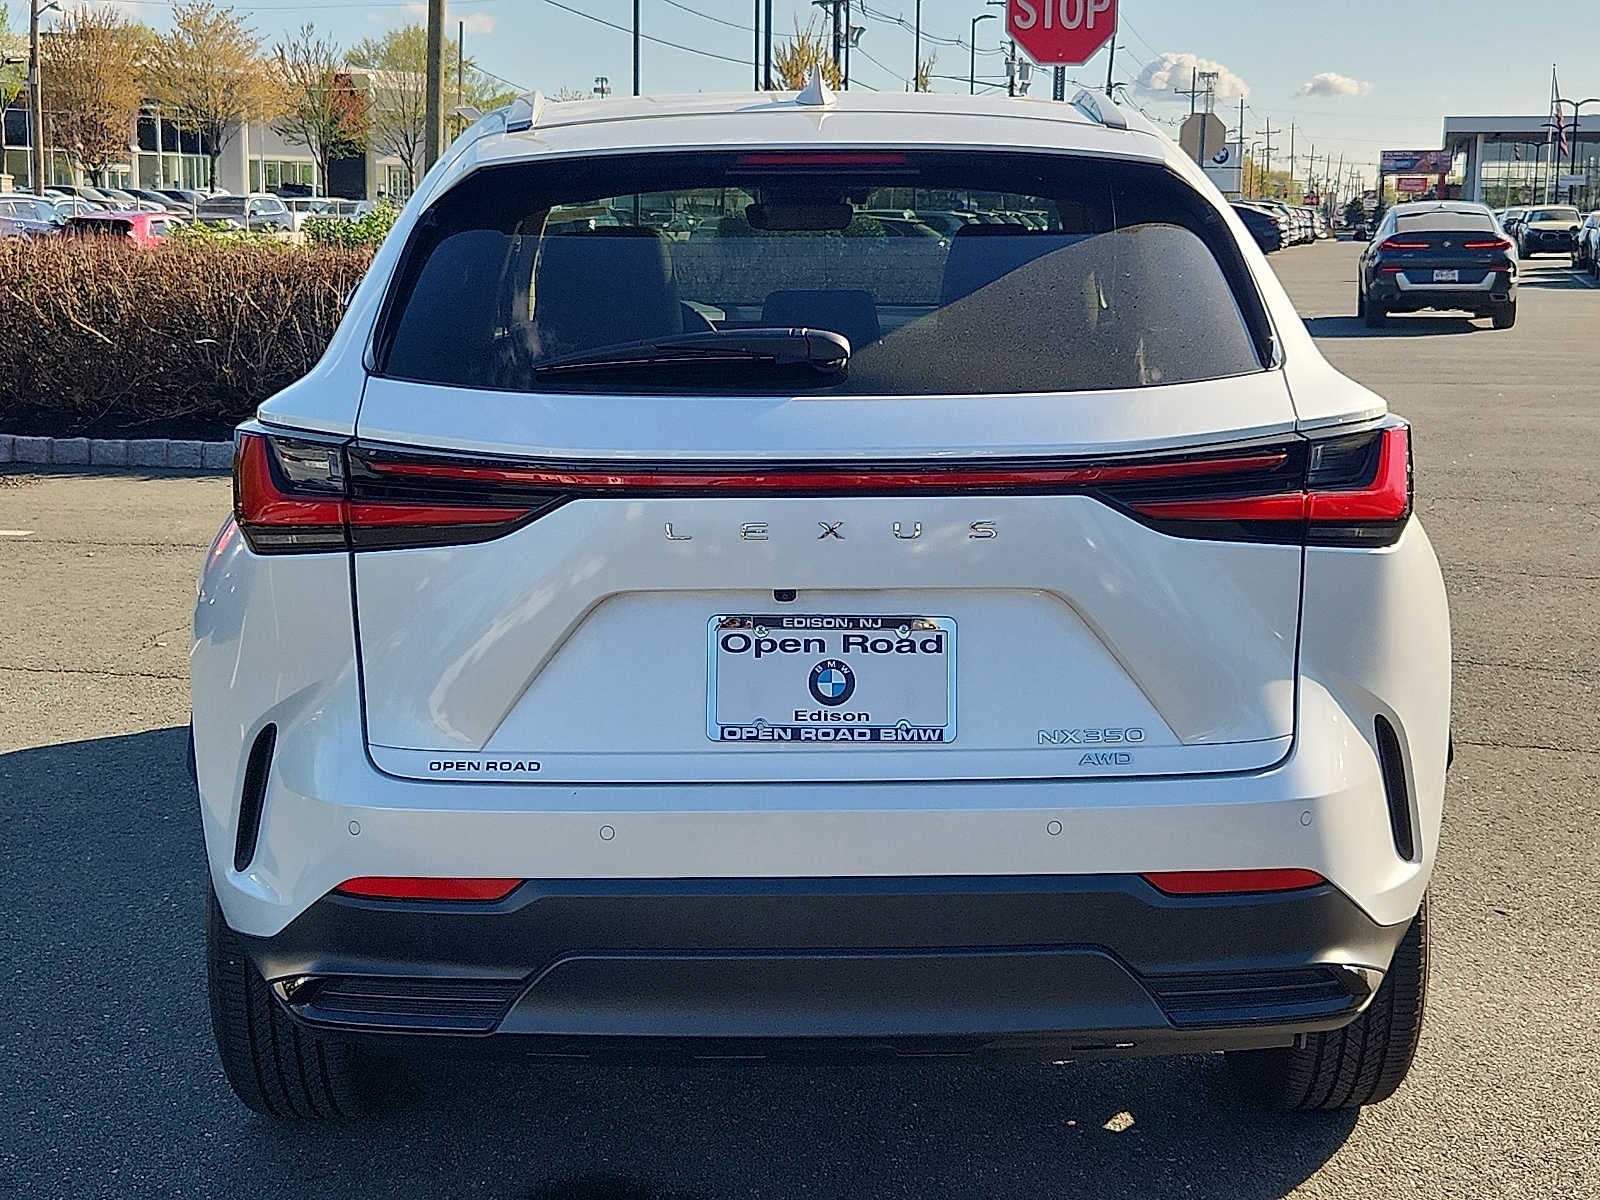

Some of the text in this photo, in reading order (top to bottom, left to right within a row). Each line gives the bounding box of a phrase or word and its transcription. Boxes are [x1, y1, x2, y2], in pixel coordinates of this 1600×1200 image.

[1014, 0, 1110, 29] STOP
[664, 520, 998, 541] LEXUS
[782, 617, 882, 629] EDISON, NJ
[720, 633, 943, 658] Open Road
[794, 710, 870, 722] Edison
[723, 728, 941, 741] OPEN ROAD BMW
[1037, 728, 1145, 745] NX350
[429, 761, 541, 771] OPEN ROAD
[1078, 752, 1132, 766] AWD
